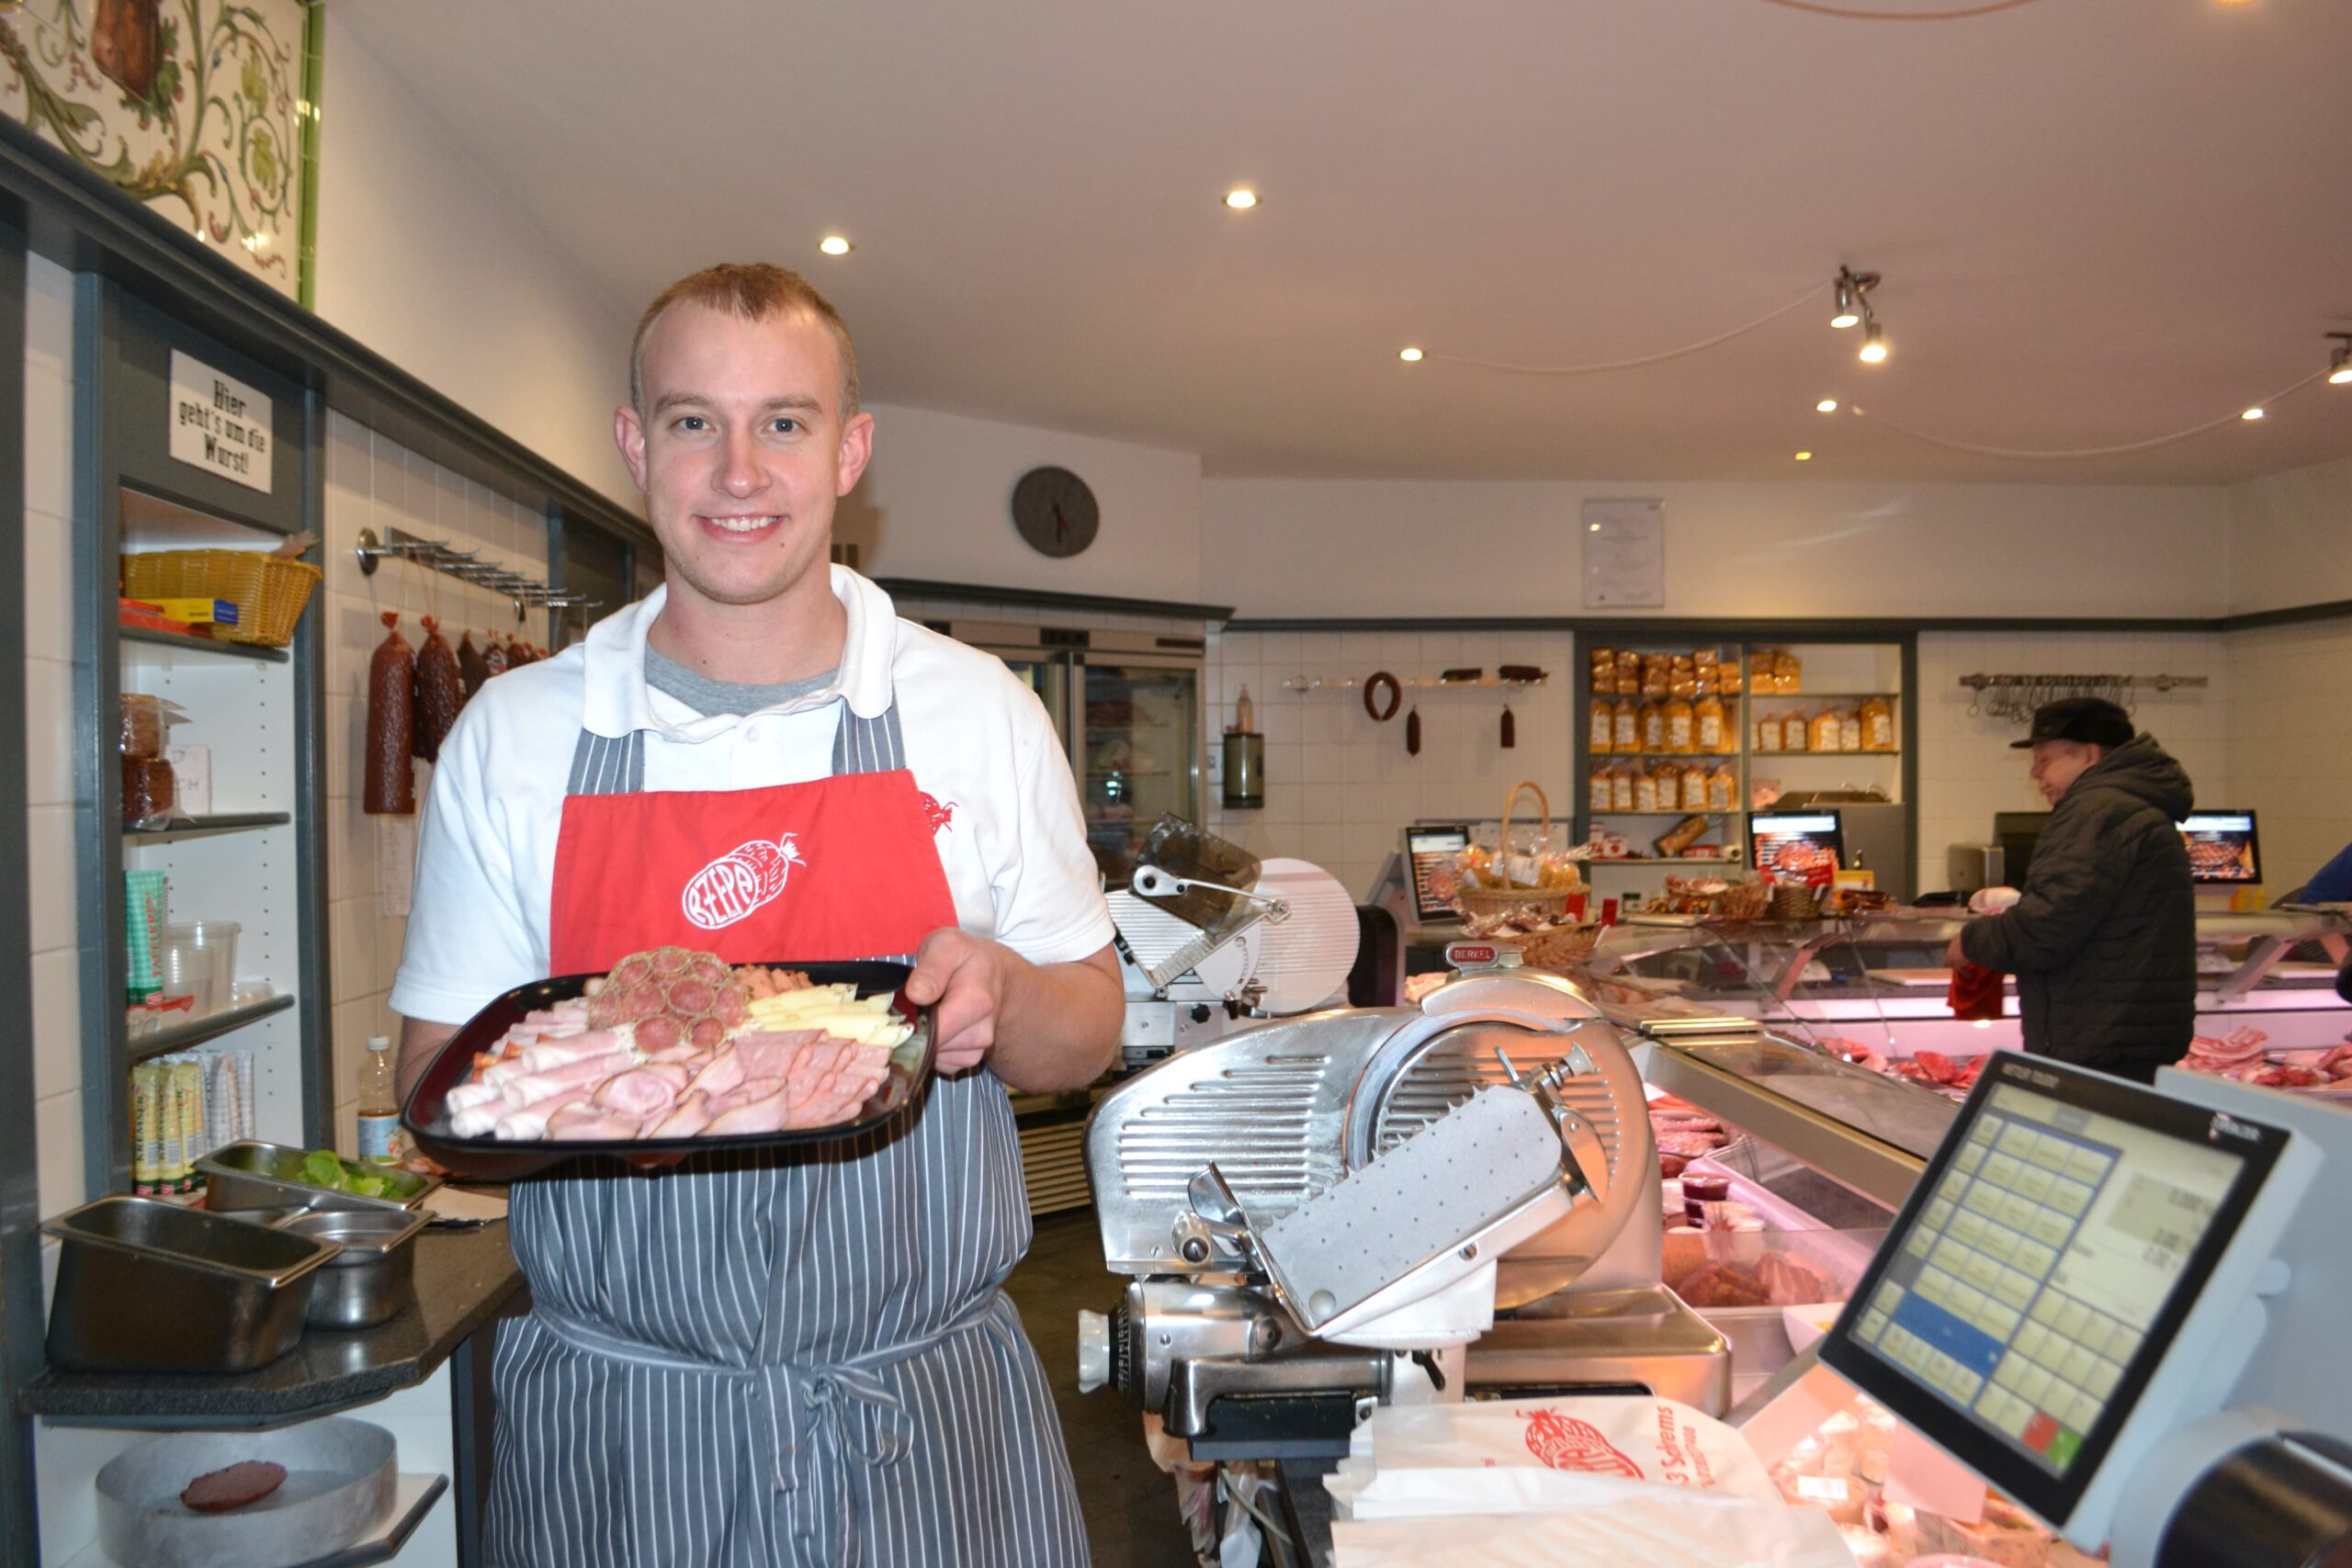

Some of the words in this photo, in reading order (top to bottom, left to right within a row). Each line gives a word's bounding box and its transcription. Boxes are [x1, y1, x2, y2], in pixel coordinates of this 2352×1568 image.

[213, 379, 246, 418] Hier
[180, 401, 221, 434] geht's
[225, 420, 245, 444] um
[248, 428, 266, 453] die
[688, 863, 753, 927] RZEPA
[1454, 950, 1491, 959] BERKEL
